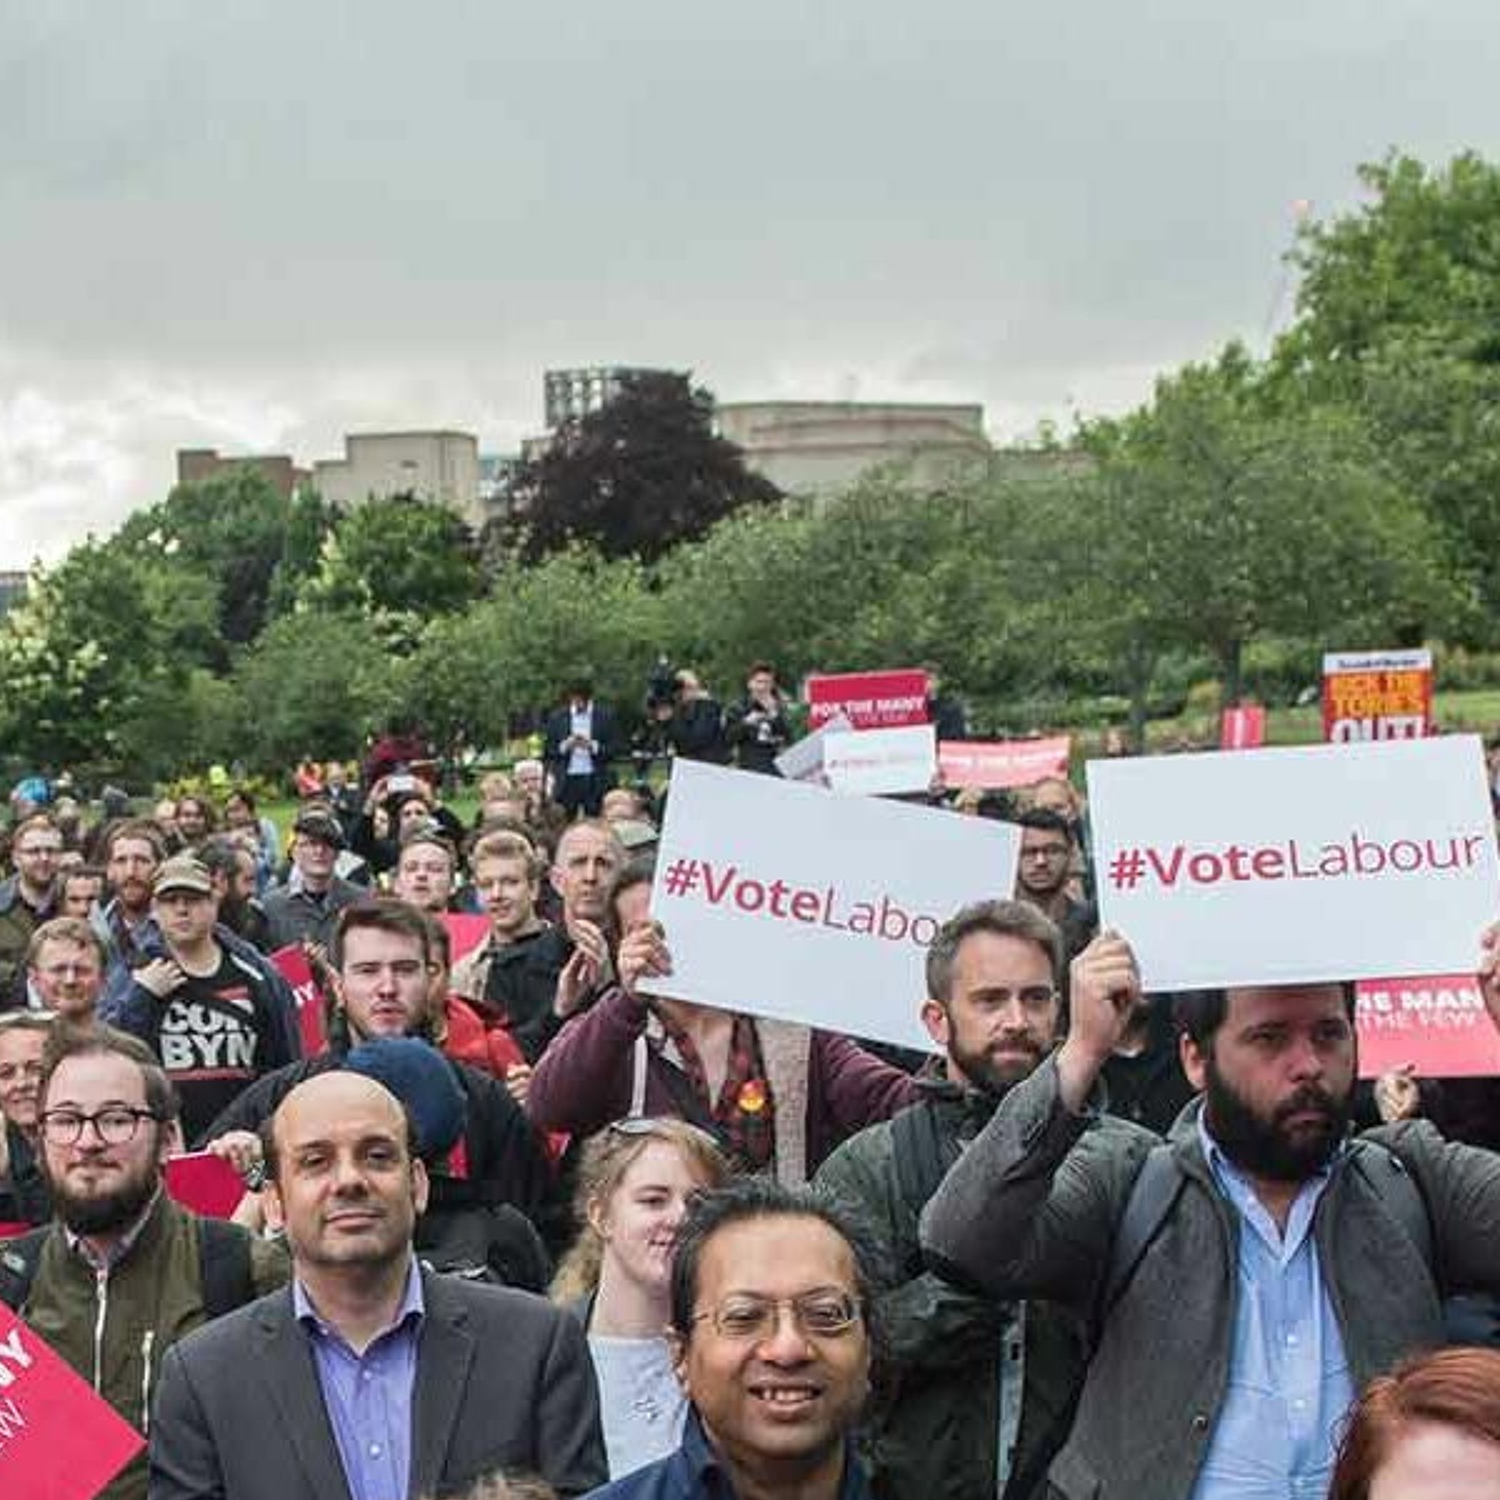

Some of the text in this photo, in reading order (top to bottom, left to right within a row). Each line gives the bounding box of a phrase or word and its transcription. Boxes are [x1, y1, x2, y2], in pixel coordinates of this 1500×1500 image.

[1109, 832, 1484, 889] #VoteLabour
[665, 859, 942, 947] #VoteLabo
[1400, 988, 1484, 1011] MAN
[160, 1031, 257, 1070] BYN
